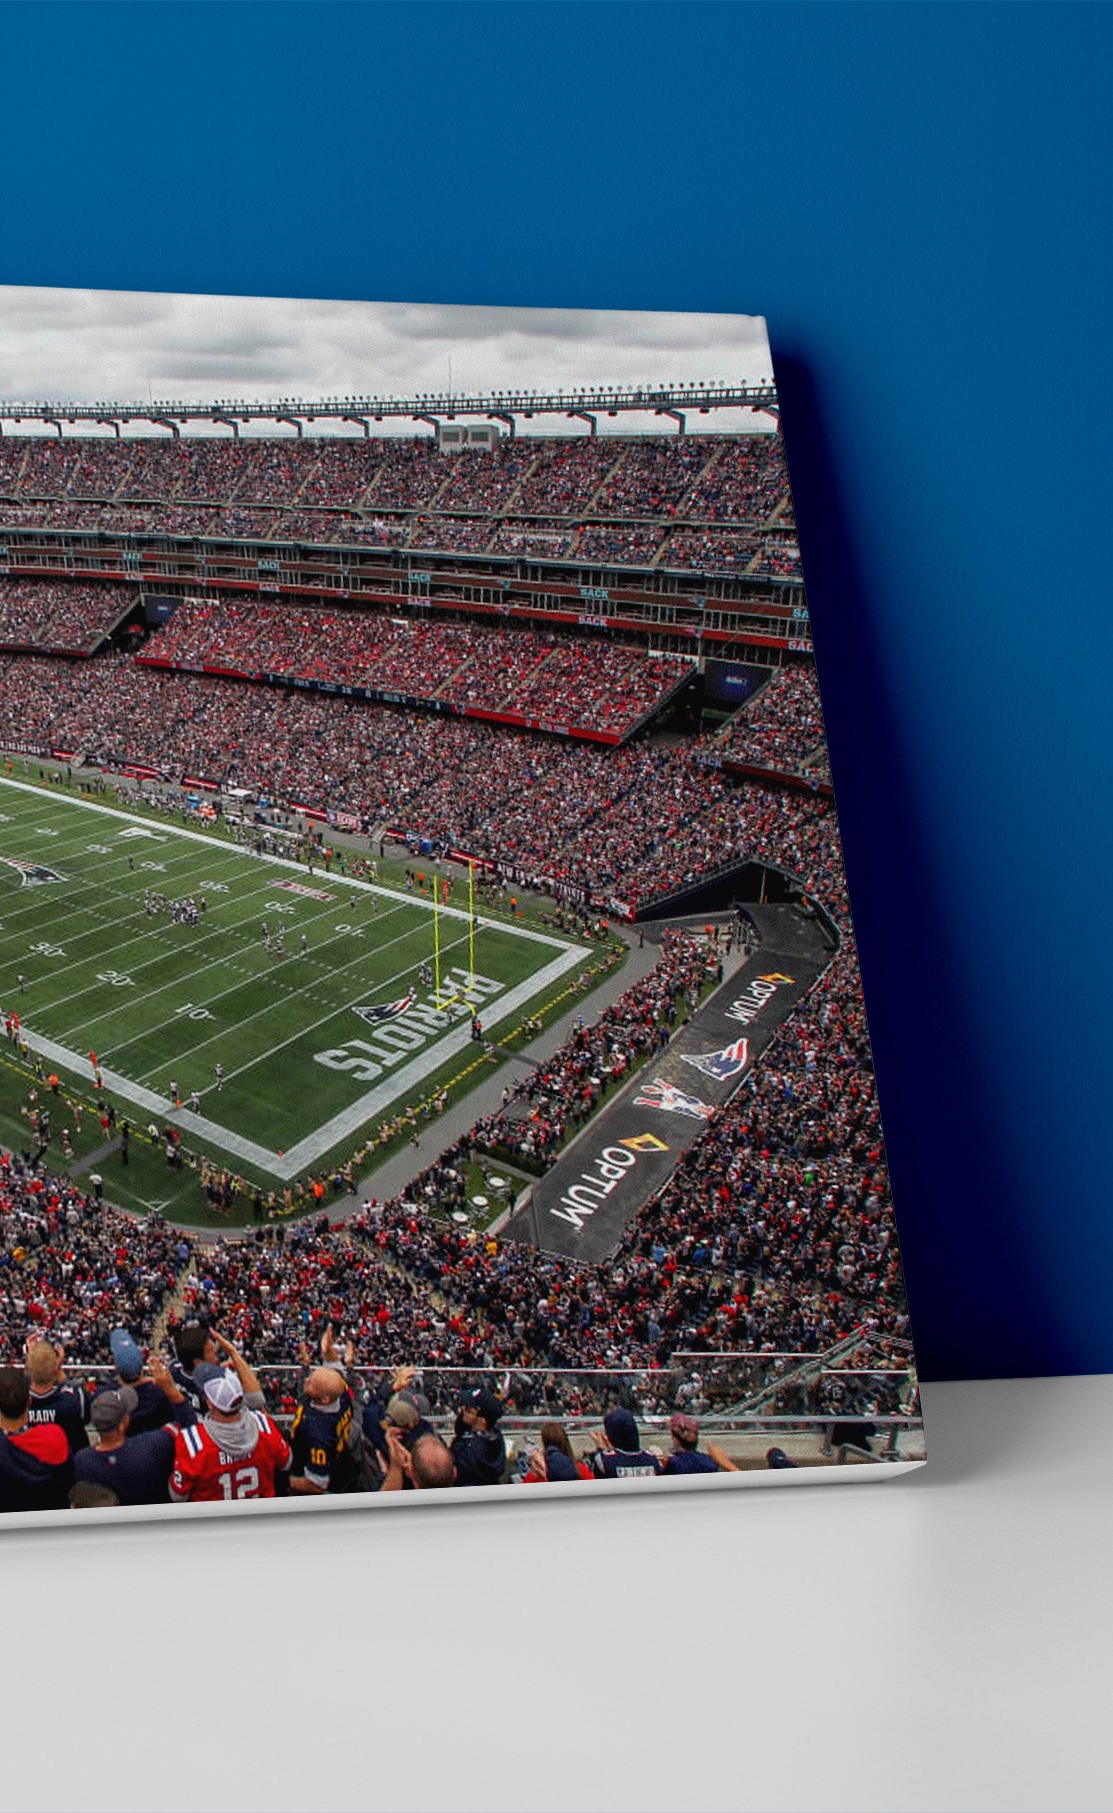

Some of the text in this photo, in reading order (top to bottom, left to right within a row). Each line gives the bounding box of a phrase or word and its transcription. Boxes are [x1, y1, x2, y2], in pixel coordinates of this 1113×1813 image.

[95, 970, 131, 986] 20
[175, 1003, 210, 1020] 10
[724, 980, 778, 1026] OPTUM
[313, 967, 507, 1082] PATRIOTS
[550, 1147, 636, 1231] OPTUM
[29, 1409, 56, 1423] RADY
[218, 1465, 261, 1501] 12
